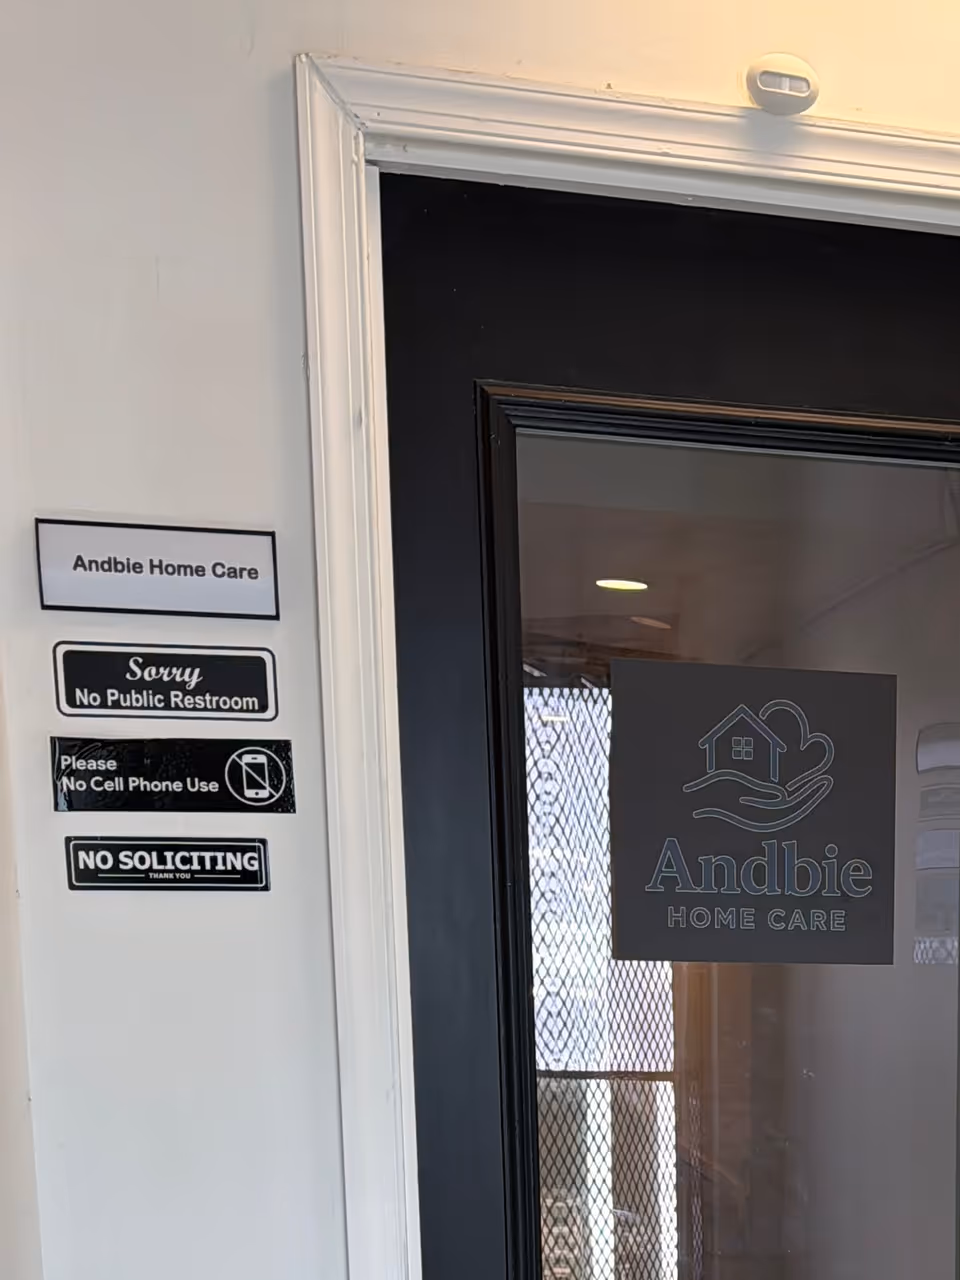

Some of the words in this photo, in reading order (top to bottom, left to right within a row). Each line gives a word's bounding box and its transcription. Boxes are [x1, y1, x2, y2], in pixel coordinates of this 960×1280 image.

[73, 555, 144, 574] Andbie
[149, 559, 206, 577] Home
[211, 562, 259, 580] Care
[125, 656, 203, 690] Sorry
[75, 688, 101, 706] No
[107, 689, 165, 708] Public
[170, 691, 259, 710] Restroom
[61, 755, 117, 771] Please
[62, 776, 87, 791] No
[90, 777, 124, 792] Cell
[128, 777, 183, 792] Phone
[187, 777, 220, 793] Use
[78, 850, 114, 870] NO
[119, 851, 259, 872] SOLICITING
[645, 837, 873, 898] Andbie
[667, 906, 756, 930] HOME
[767, 908, 847, 931] CARE
